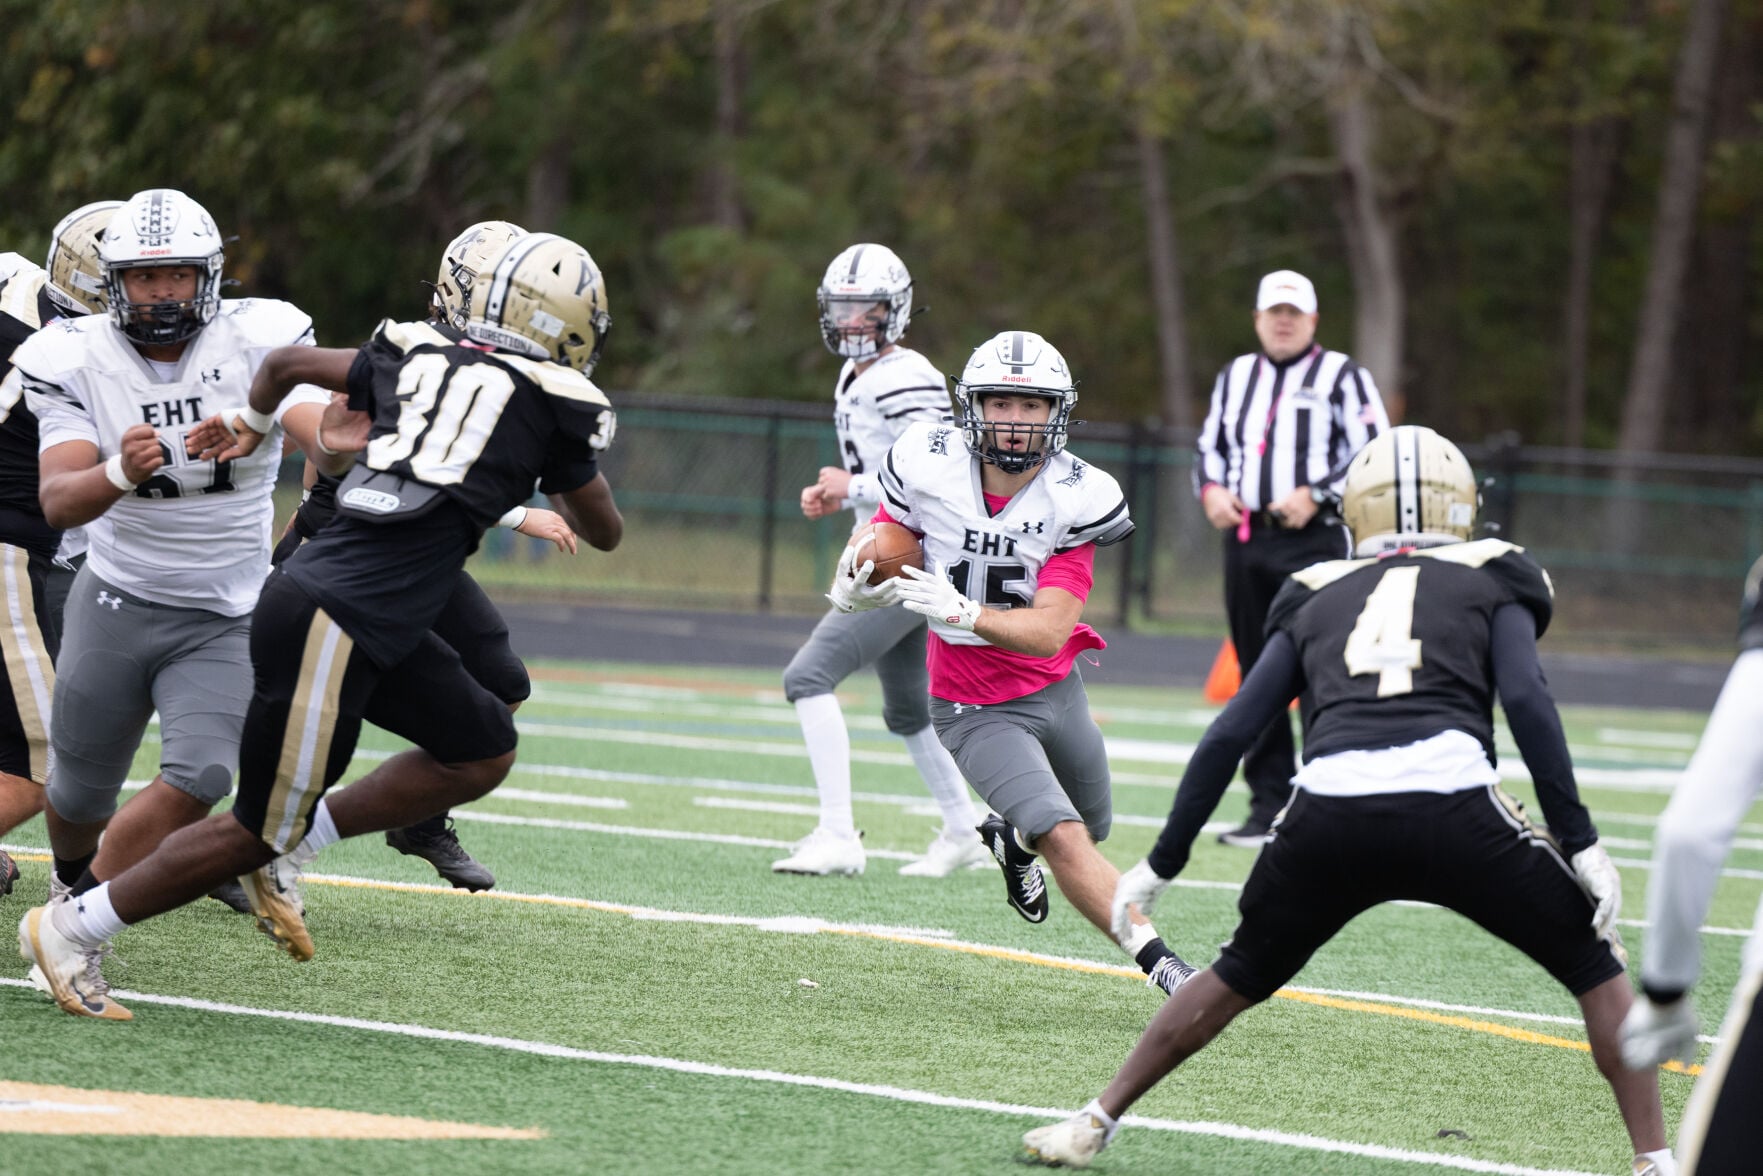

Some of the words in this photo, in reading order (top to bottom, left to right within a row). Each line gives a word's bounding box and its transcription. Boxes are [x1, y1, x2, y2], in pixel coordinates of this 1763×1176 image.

[1001, 375, 1032, 383] Riddell
[140, 397, 203, 428] EHT
[367, 353, 516, 485] 30
[961, 528, 1018, 557] EHT
[946, 557, 1032, 610] 15
[1344, 565, 1424, 698] 4
